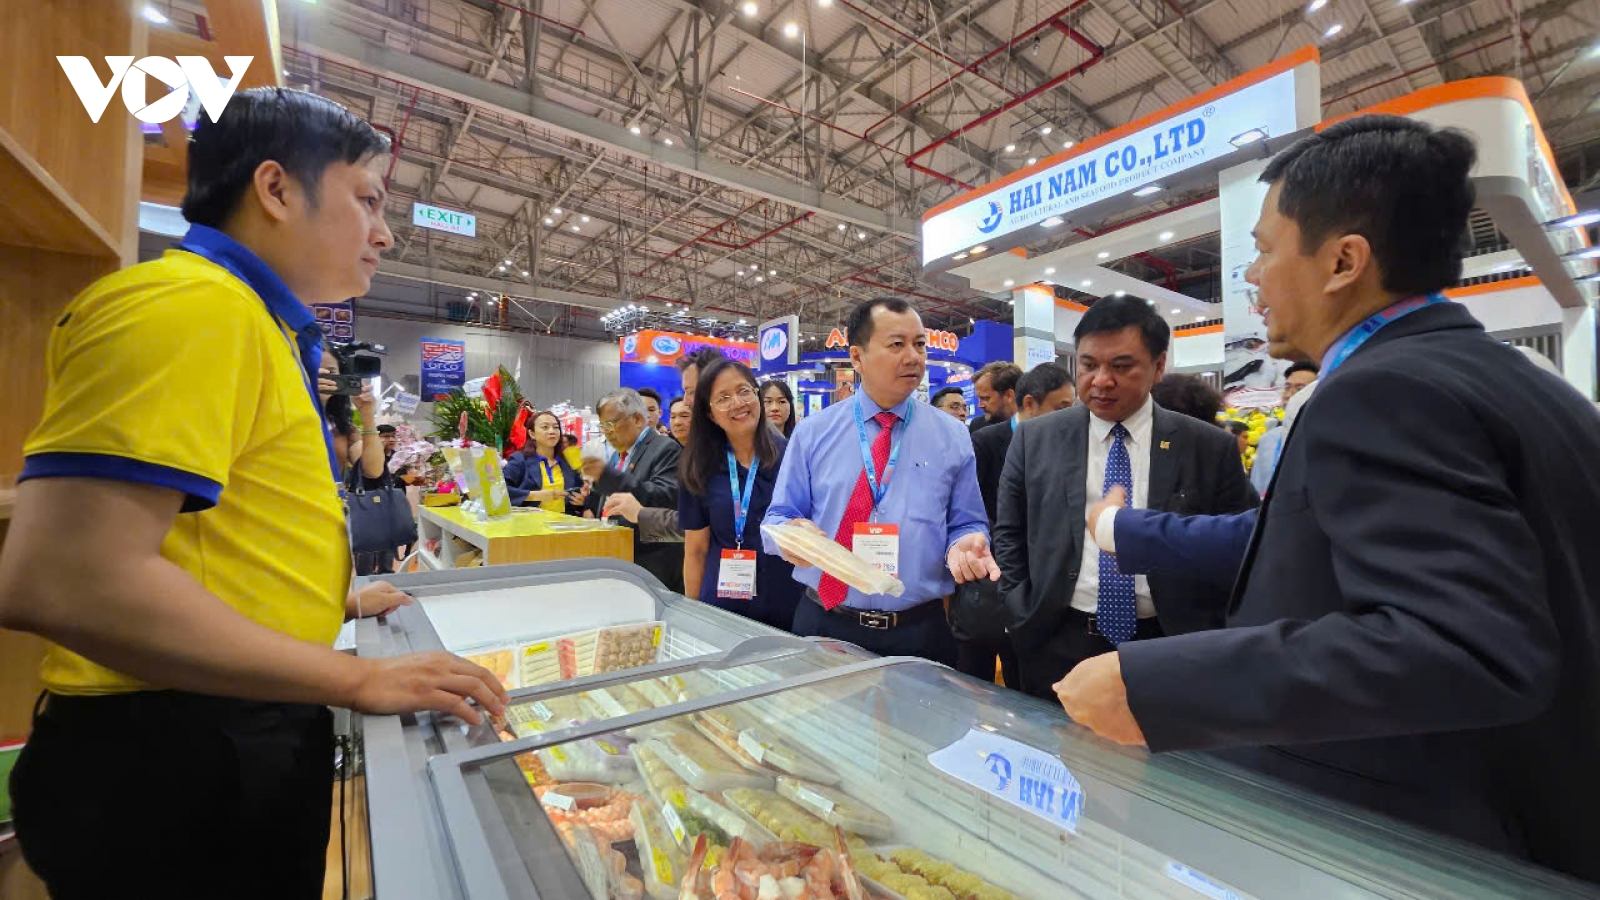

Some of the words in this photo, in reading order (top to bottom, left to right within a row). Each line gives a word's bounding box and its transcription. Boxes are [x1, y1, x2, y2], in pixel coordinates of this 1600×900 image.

[1010, 181, 1042, 214] HAI
[1048, 159, 1097, 200] NAM
[1104, 118, 1205, 178] CO.,LTD
[1064, 194, 1080, 206] AND
[1118, 165, 1157, 187] PRODUCT
[1160, 147, 1206, 170] COMPANY
[427, 208, 463, 226] EXIT
